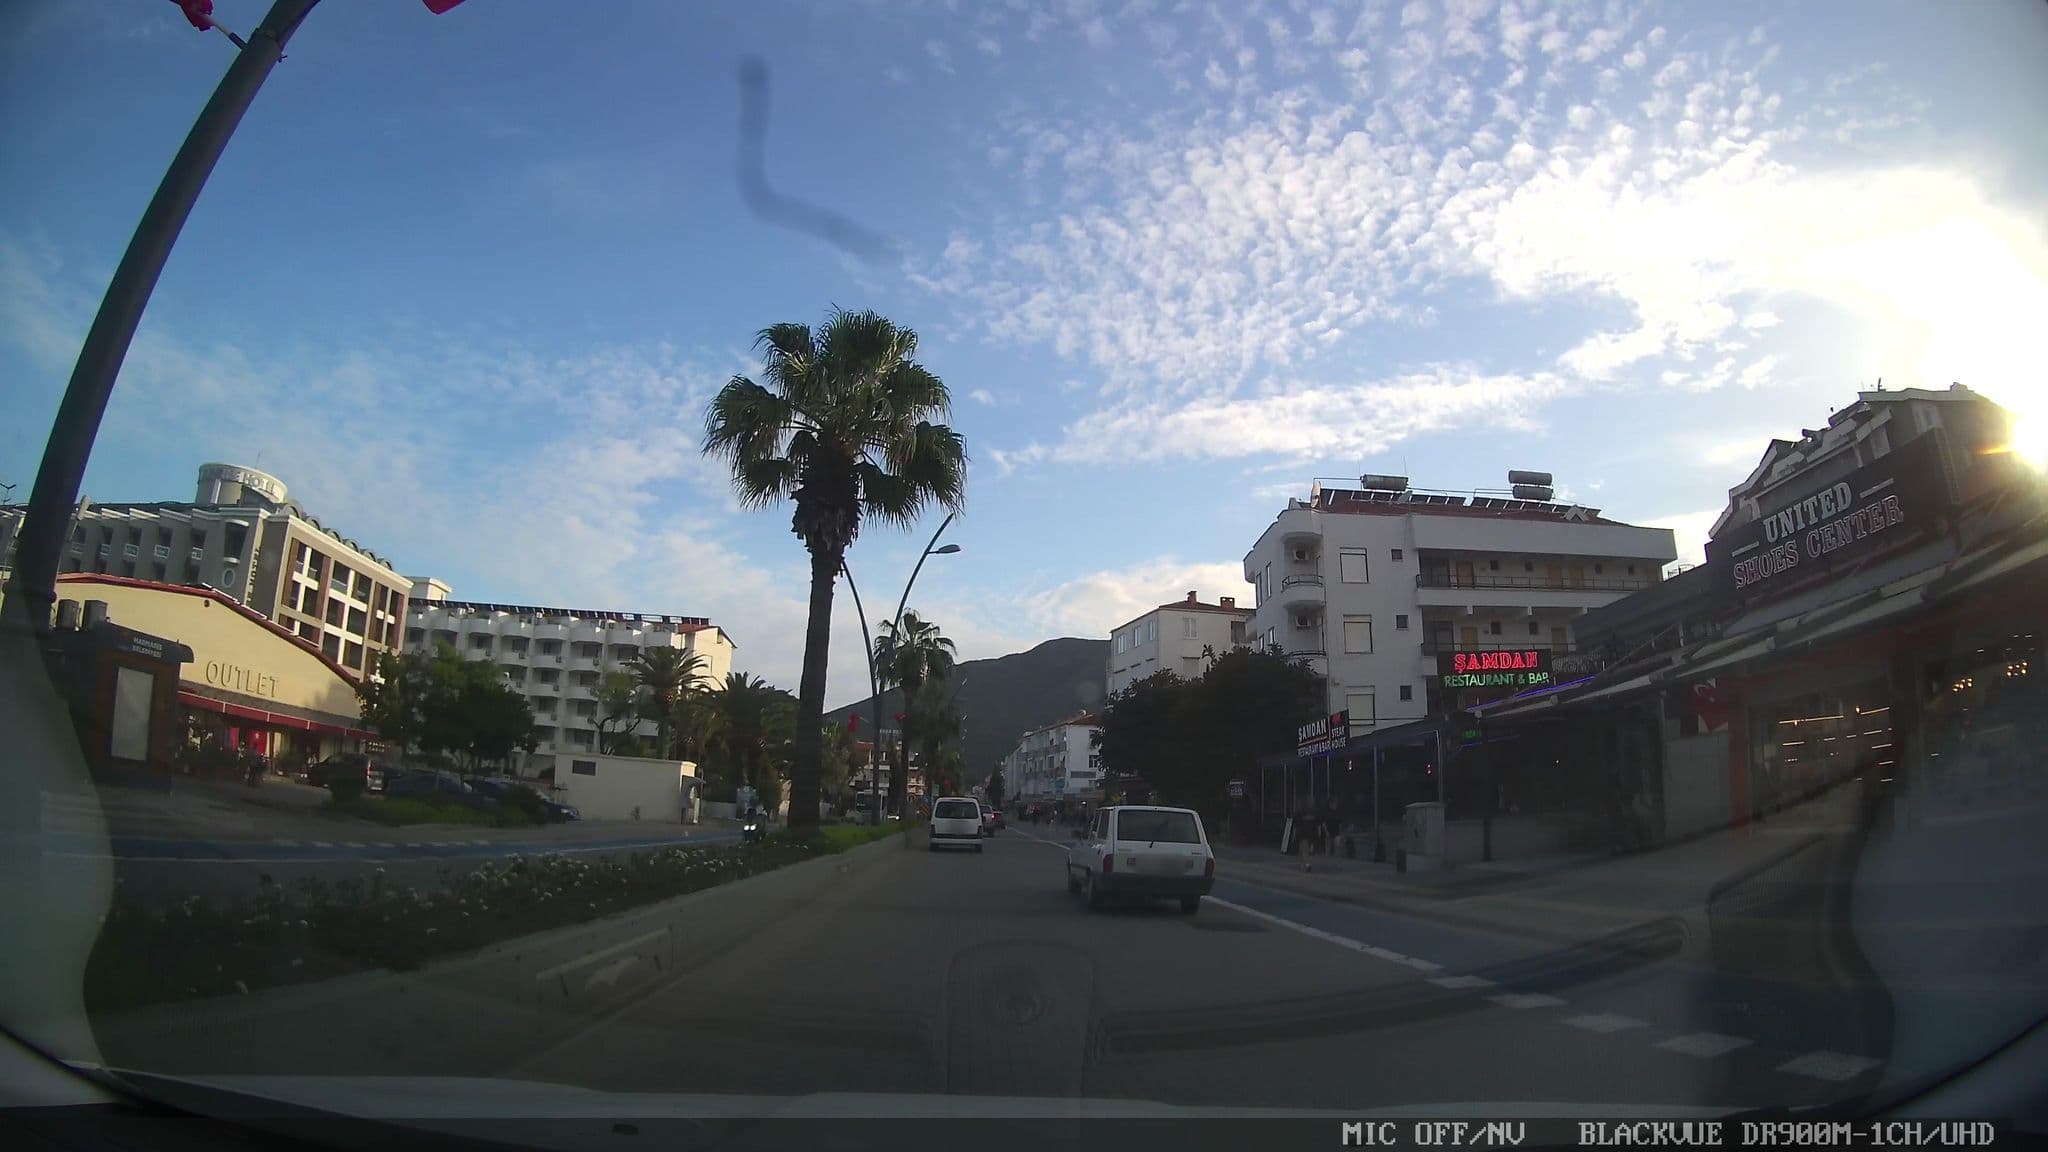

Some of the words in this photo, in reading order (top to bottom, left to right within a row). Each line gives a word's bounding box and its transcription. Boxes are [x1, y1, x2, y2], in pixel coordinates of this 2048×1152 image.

[1762, 481, 1853, 543] UNITED
[1733, 539, 1799, 589] SHOES
[1806, 494, 1905, 558] CENTER
[206, 660, 277, 698] OUTLET
[1444, 673, 1515, 688] RESTAURANT
[1519, 674, 1526, 684] &
[1528, 672, 1549, 685] BAR
